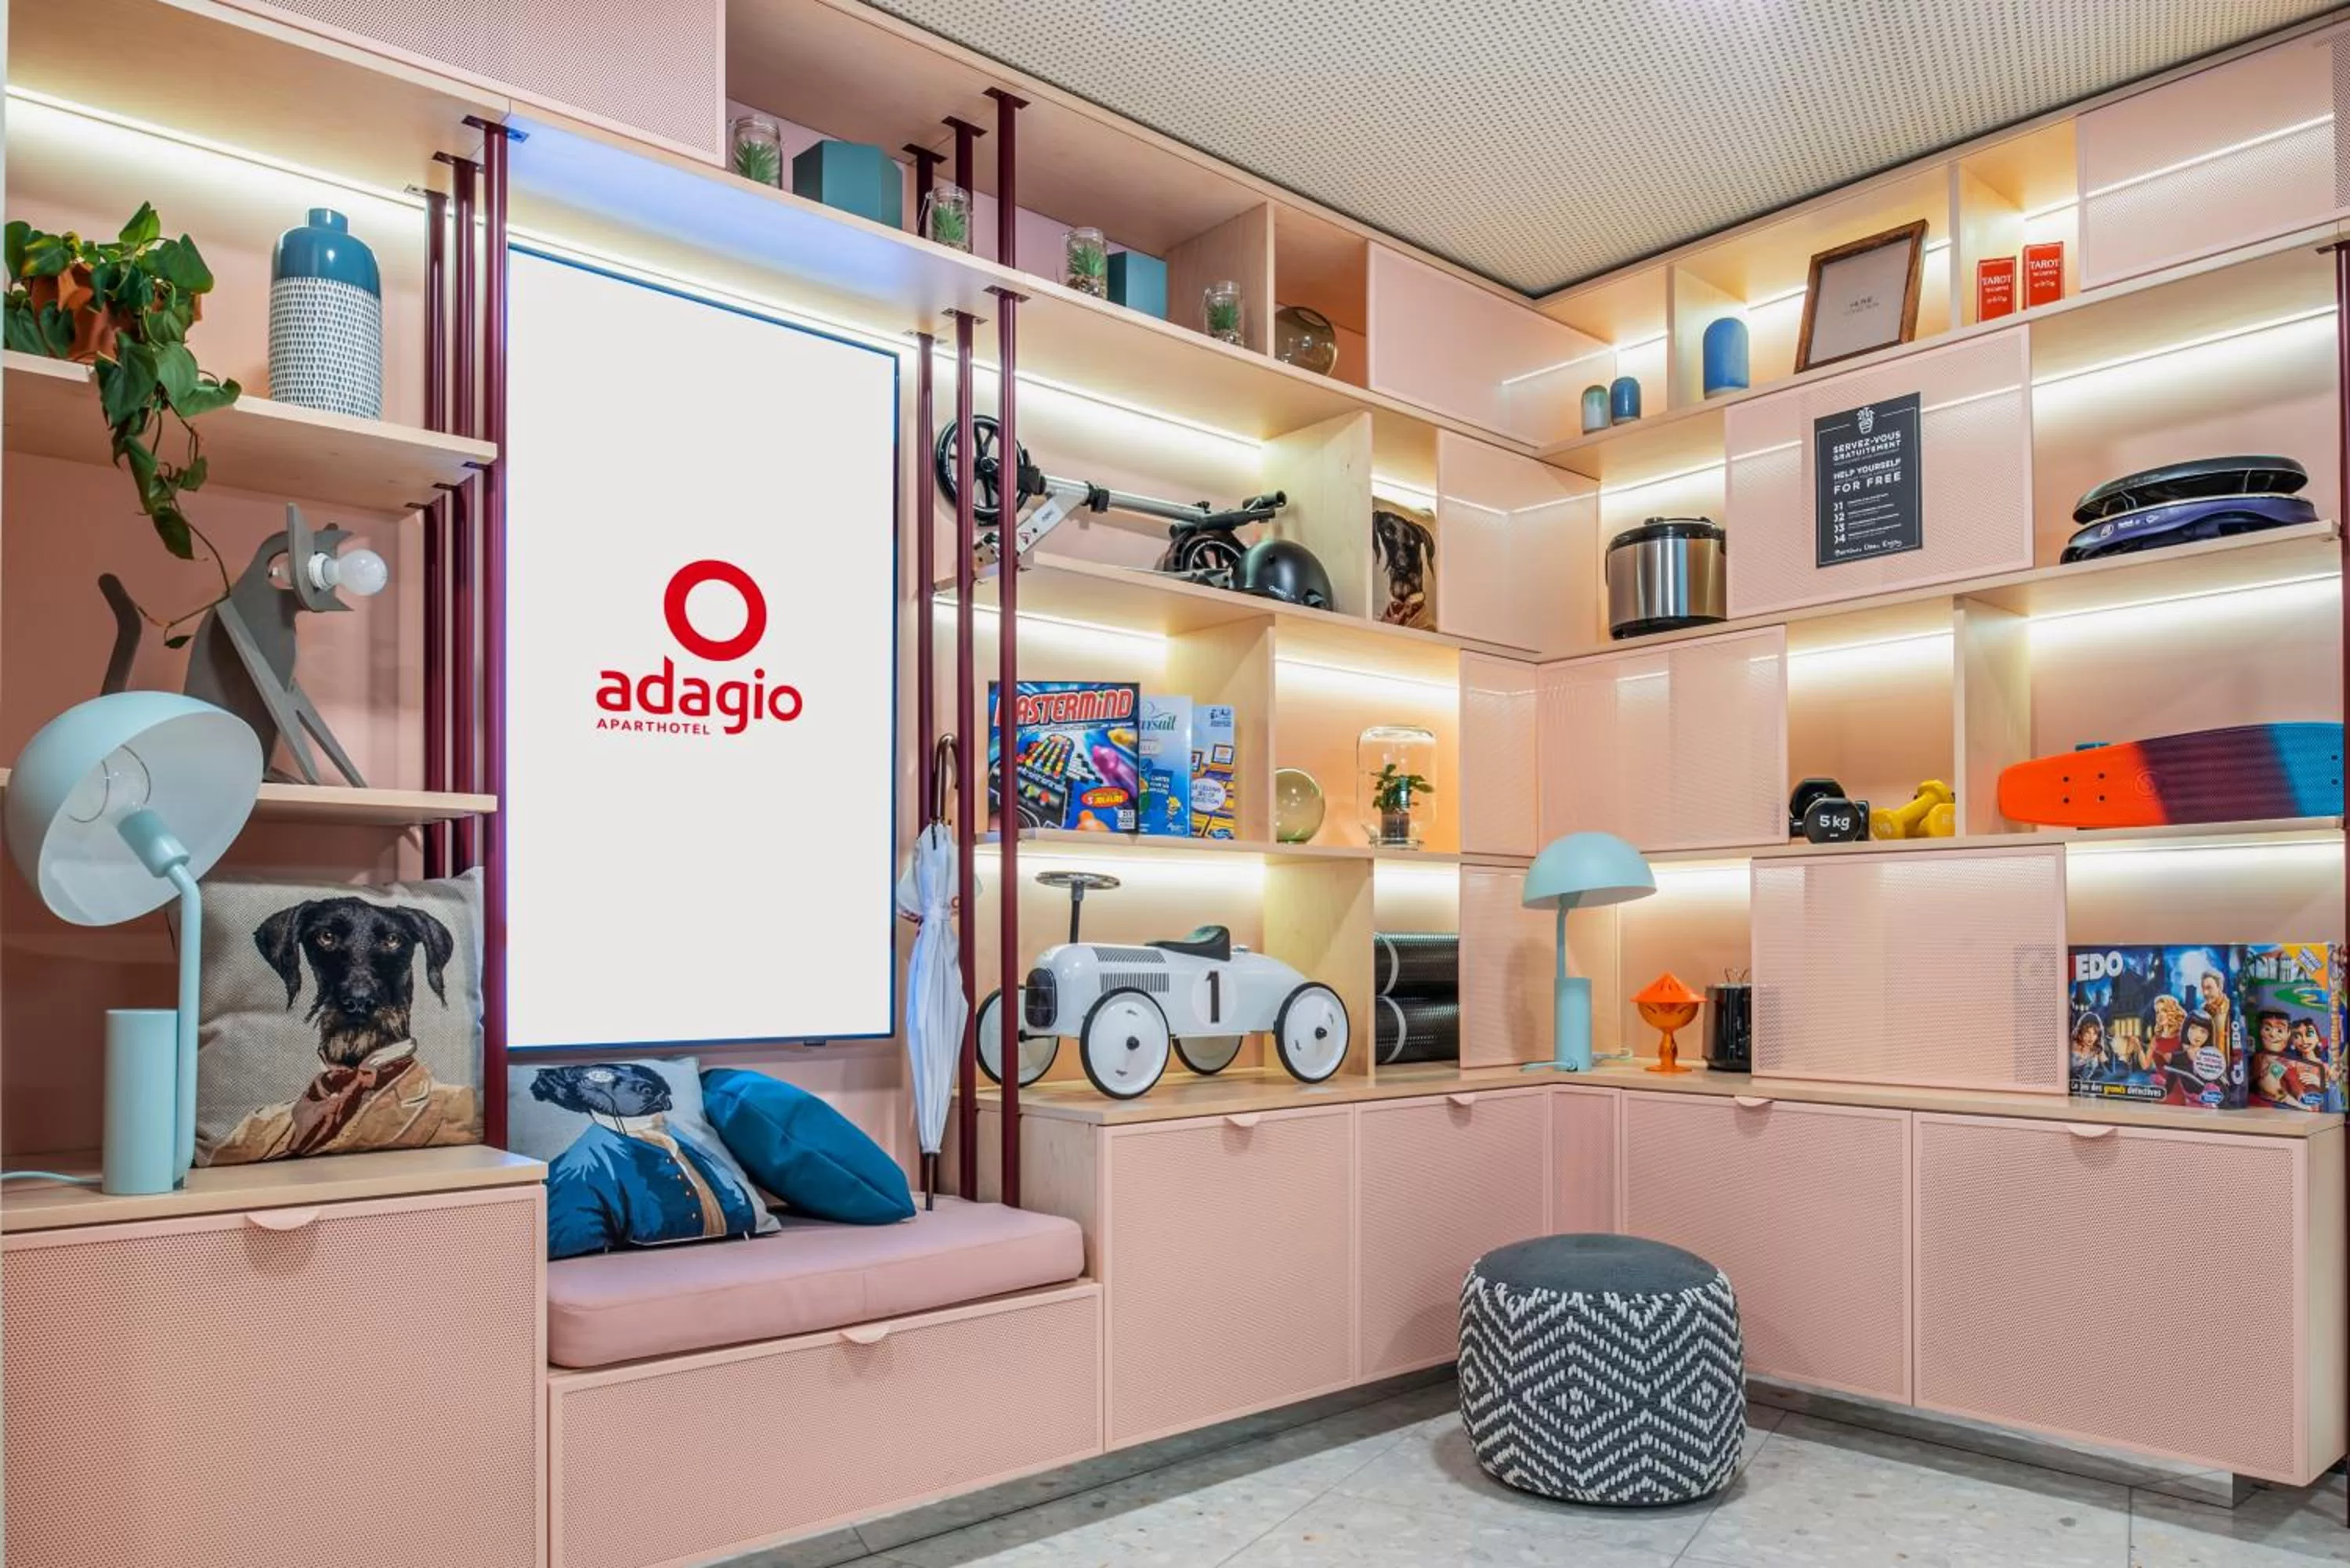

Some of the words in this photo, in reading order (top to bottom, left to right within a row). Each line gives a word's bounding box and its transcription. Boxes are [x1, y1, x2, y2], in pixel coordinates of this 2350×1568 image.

[2030, 258, 2059, 269] TAROT
[1981, 276, 2012, 286] TAROT
[1833, 431, 1901, 453] SERVEZ-VOUS
[1833, 439, 1901, 461] GRATUITEMENT
[1834, 469, 1855, 480] HELP
[1856, 457, 1901, 474] YOURSELF
[1834, 480, 1860, 495] FOR
[1867, 471, 1901, 488] FREE
[596, 655, 803, 735] adagio
[596, 718, 710, 735] APARTHOTEL
[1820, 815, 1831, 827] 5
[1832, 815, 1850, 831] kg
[2068, 950, 2124, 981] EDO
[1205, 970, 1220, 1024] 1
